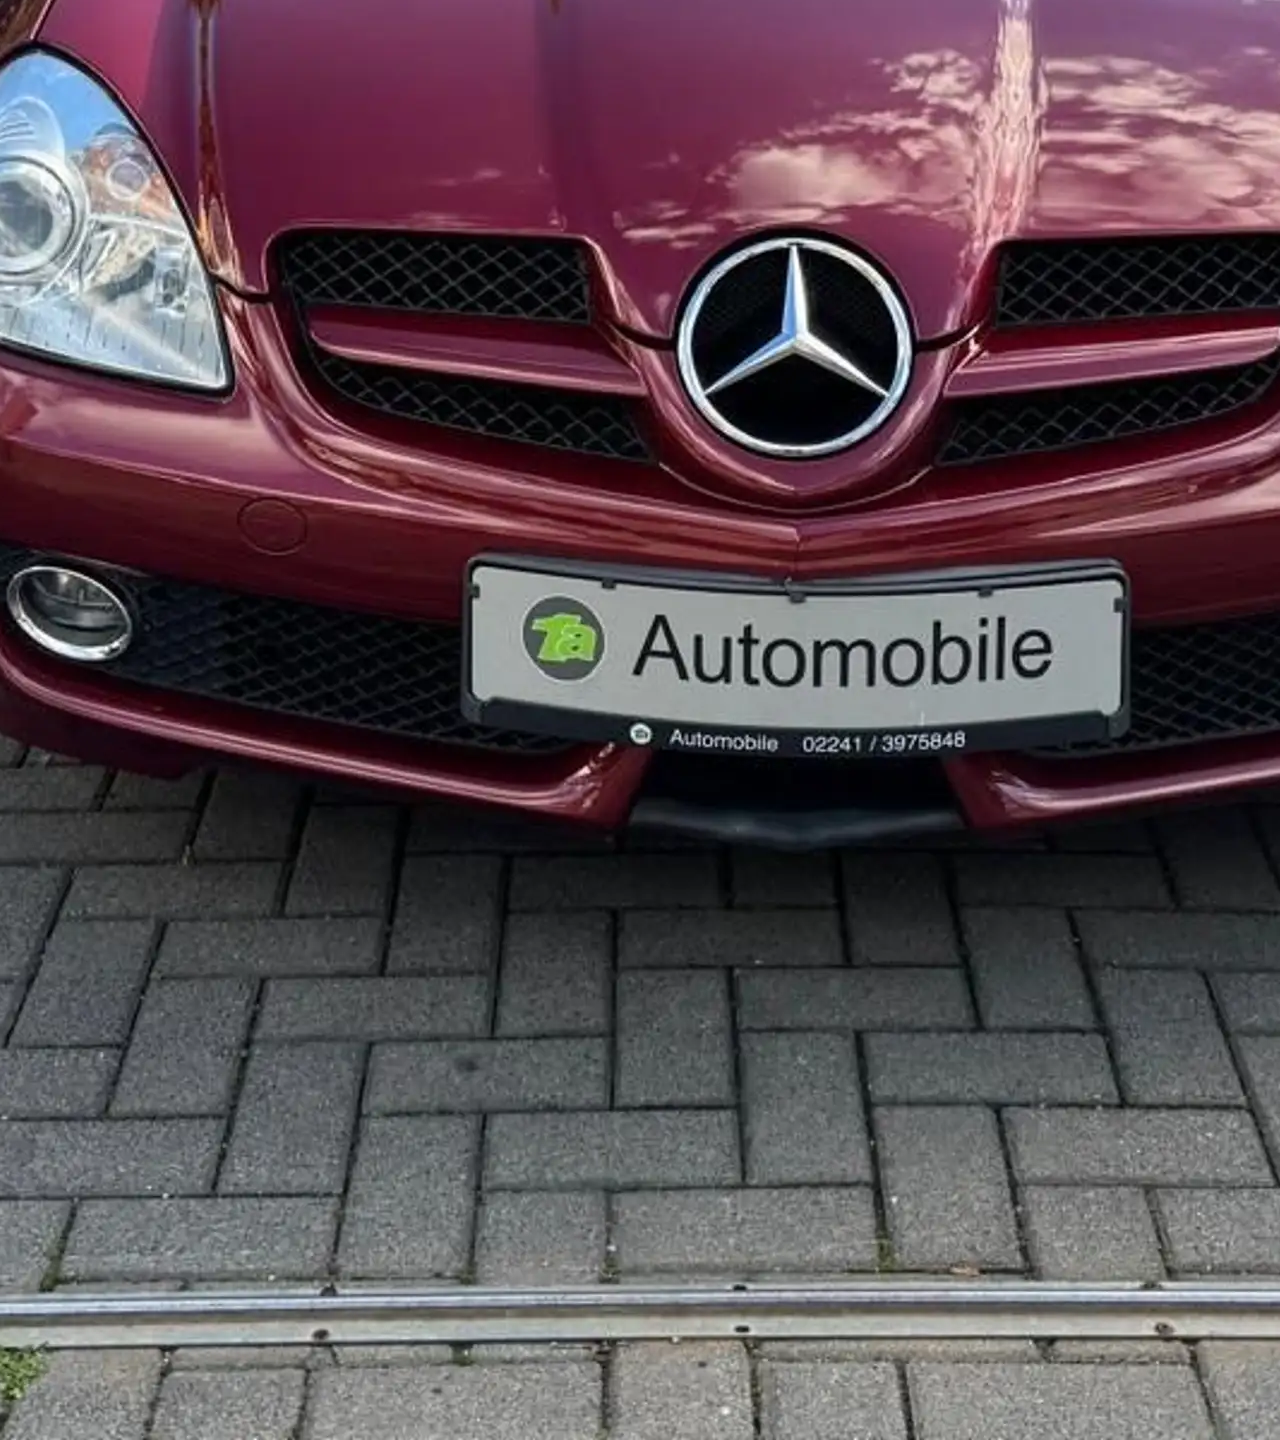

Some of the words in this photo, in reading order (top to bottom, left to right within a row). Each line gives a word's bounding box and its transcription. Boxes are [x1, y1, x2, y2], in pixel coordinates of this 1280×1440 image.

[531, 612, 598, 663] 1a
[632, 613, 1054, 689] Automobile
[669, 728, 779, 753] Automobile
[802, 736, 862, 753] 02241
[881, 730, 967, 753] 3975848
